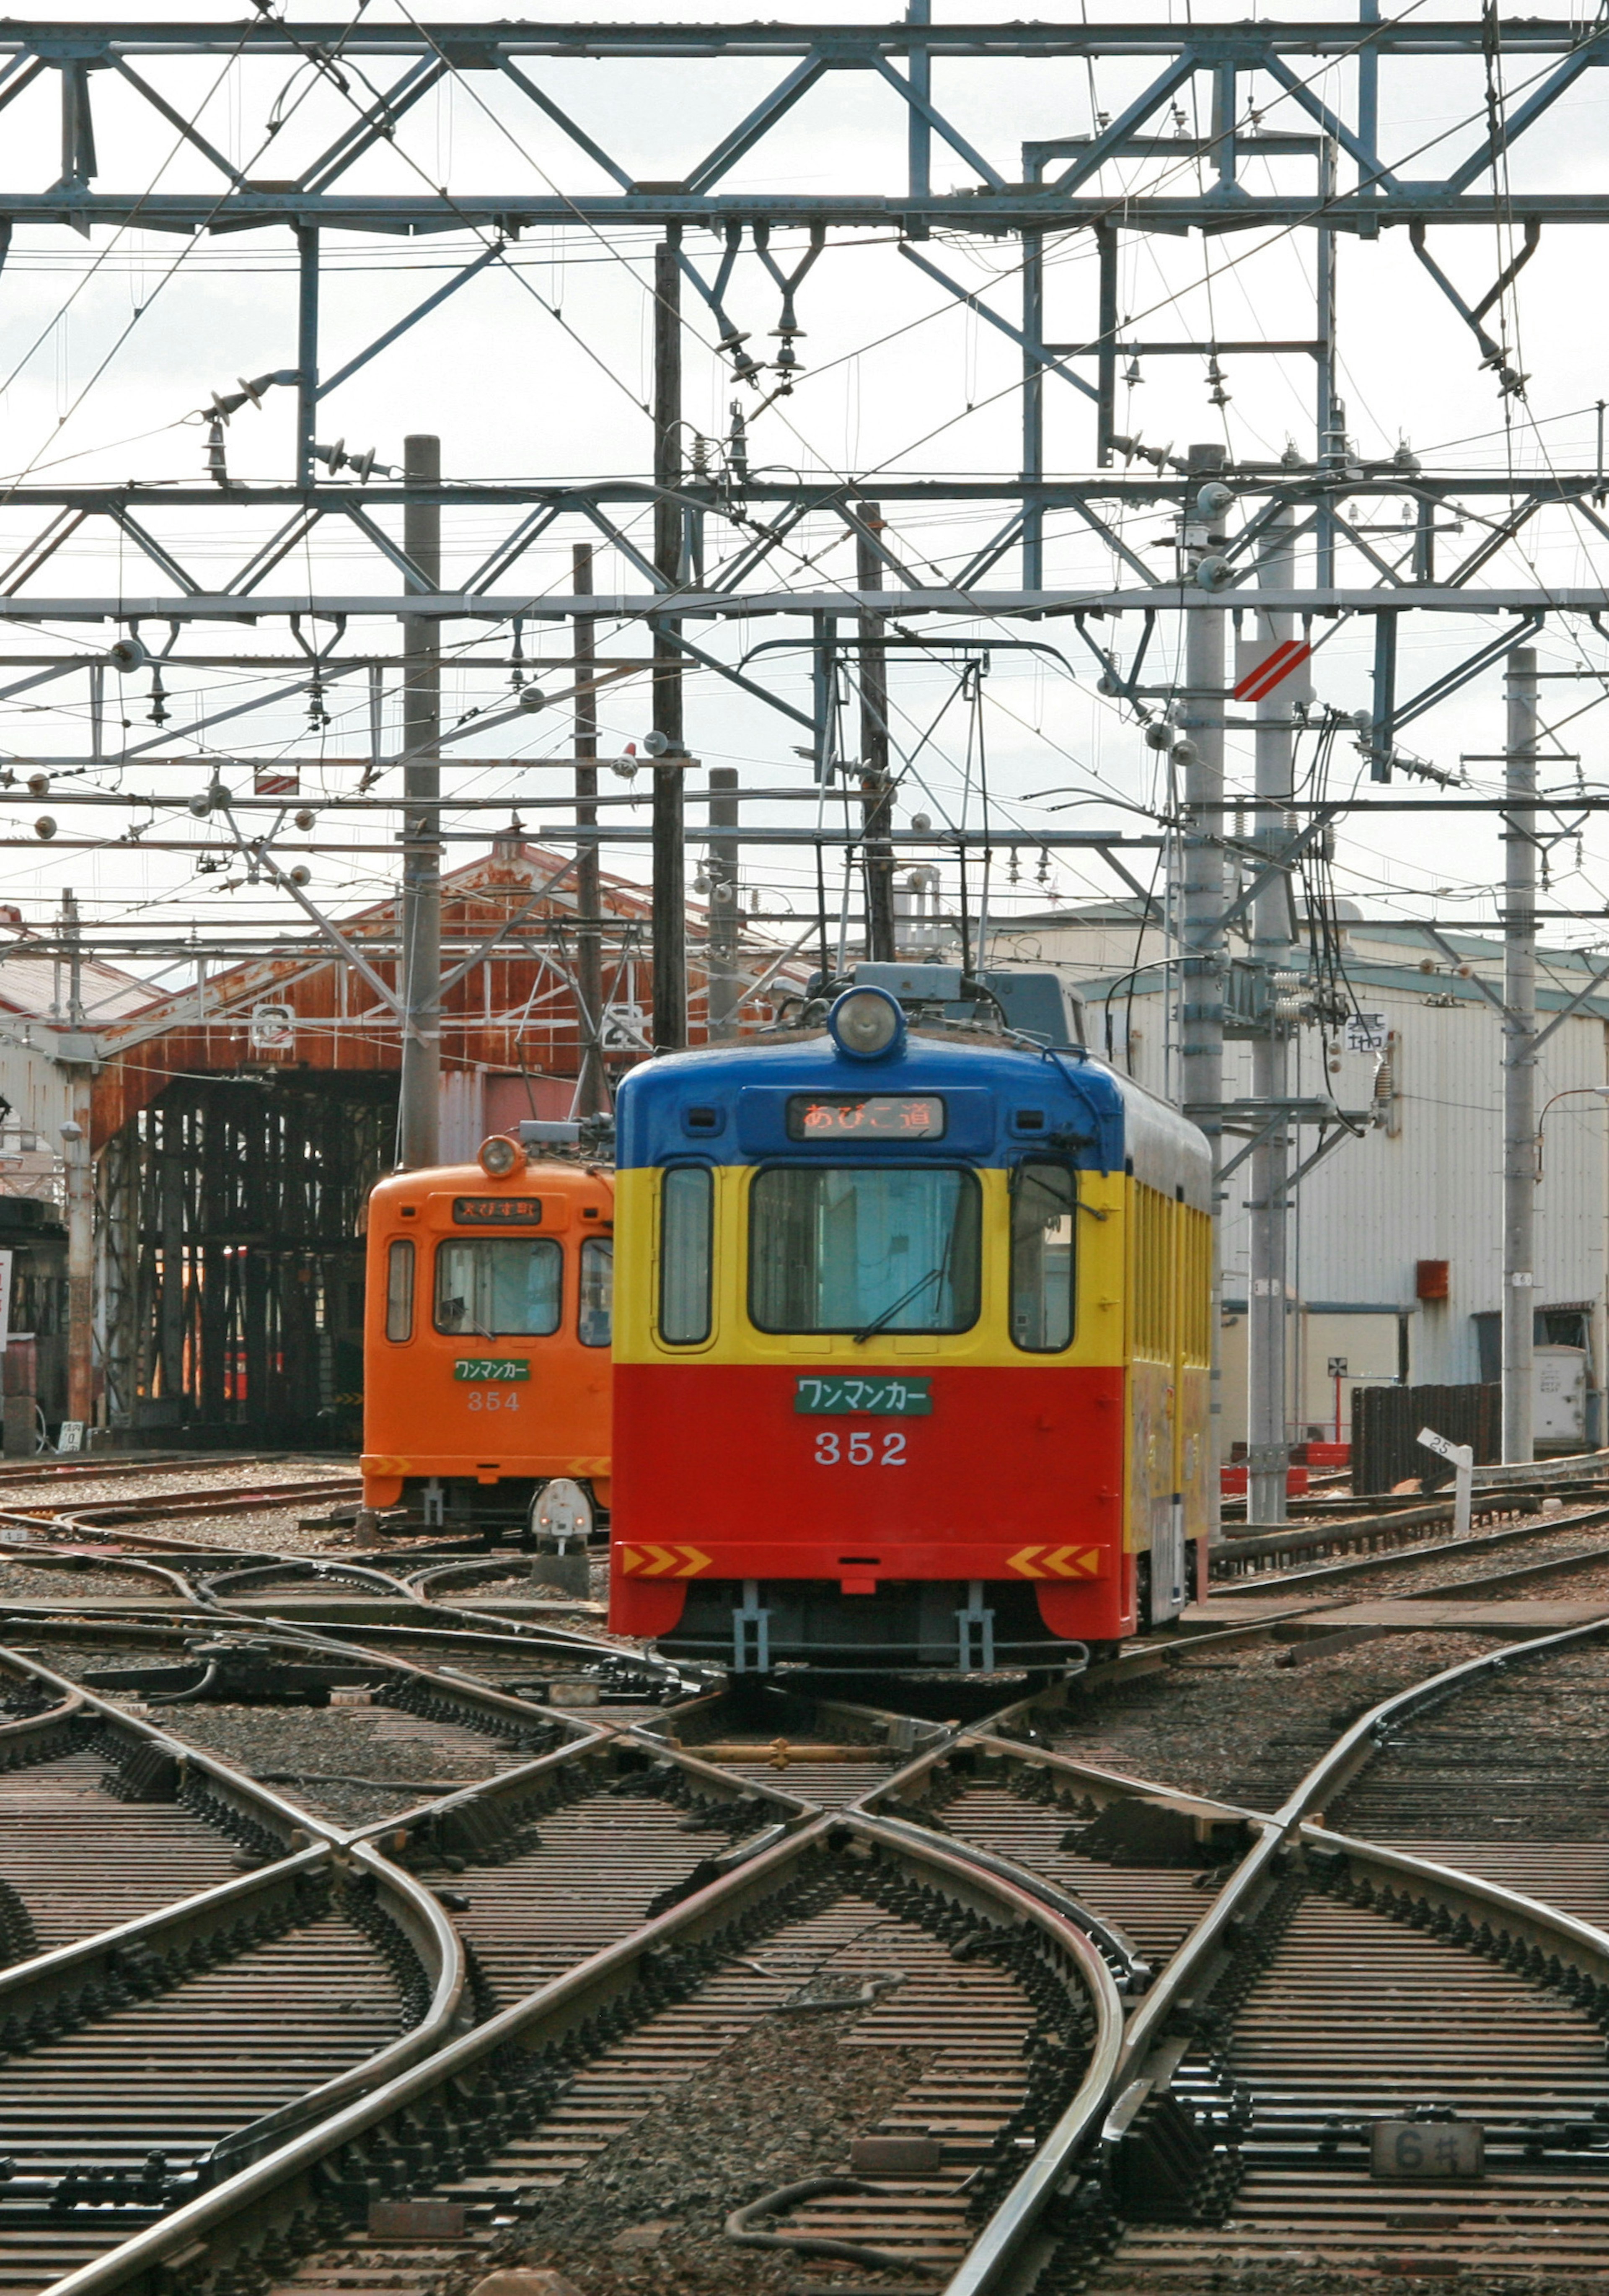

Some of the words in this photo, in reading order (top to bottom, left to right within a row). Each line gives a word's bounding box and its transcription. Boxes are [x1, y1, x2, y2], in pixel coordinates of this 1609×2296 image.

[803, 1103, 932, 1130] あびこ道
[455, 1360, 527, 1379] ワンマンカー
[467, 1391, 520, 1412] 354
[798, 1379, 927, 1411] ワンマンカー
[814, 1431, 907, 1466] 352
[1429, 1436, 1451, 1454] 25
